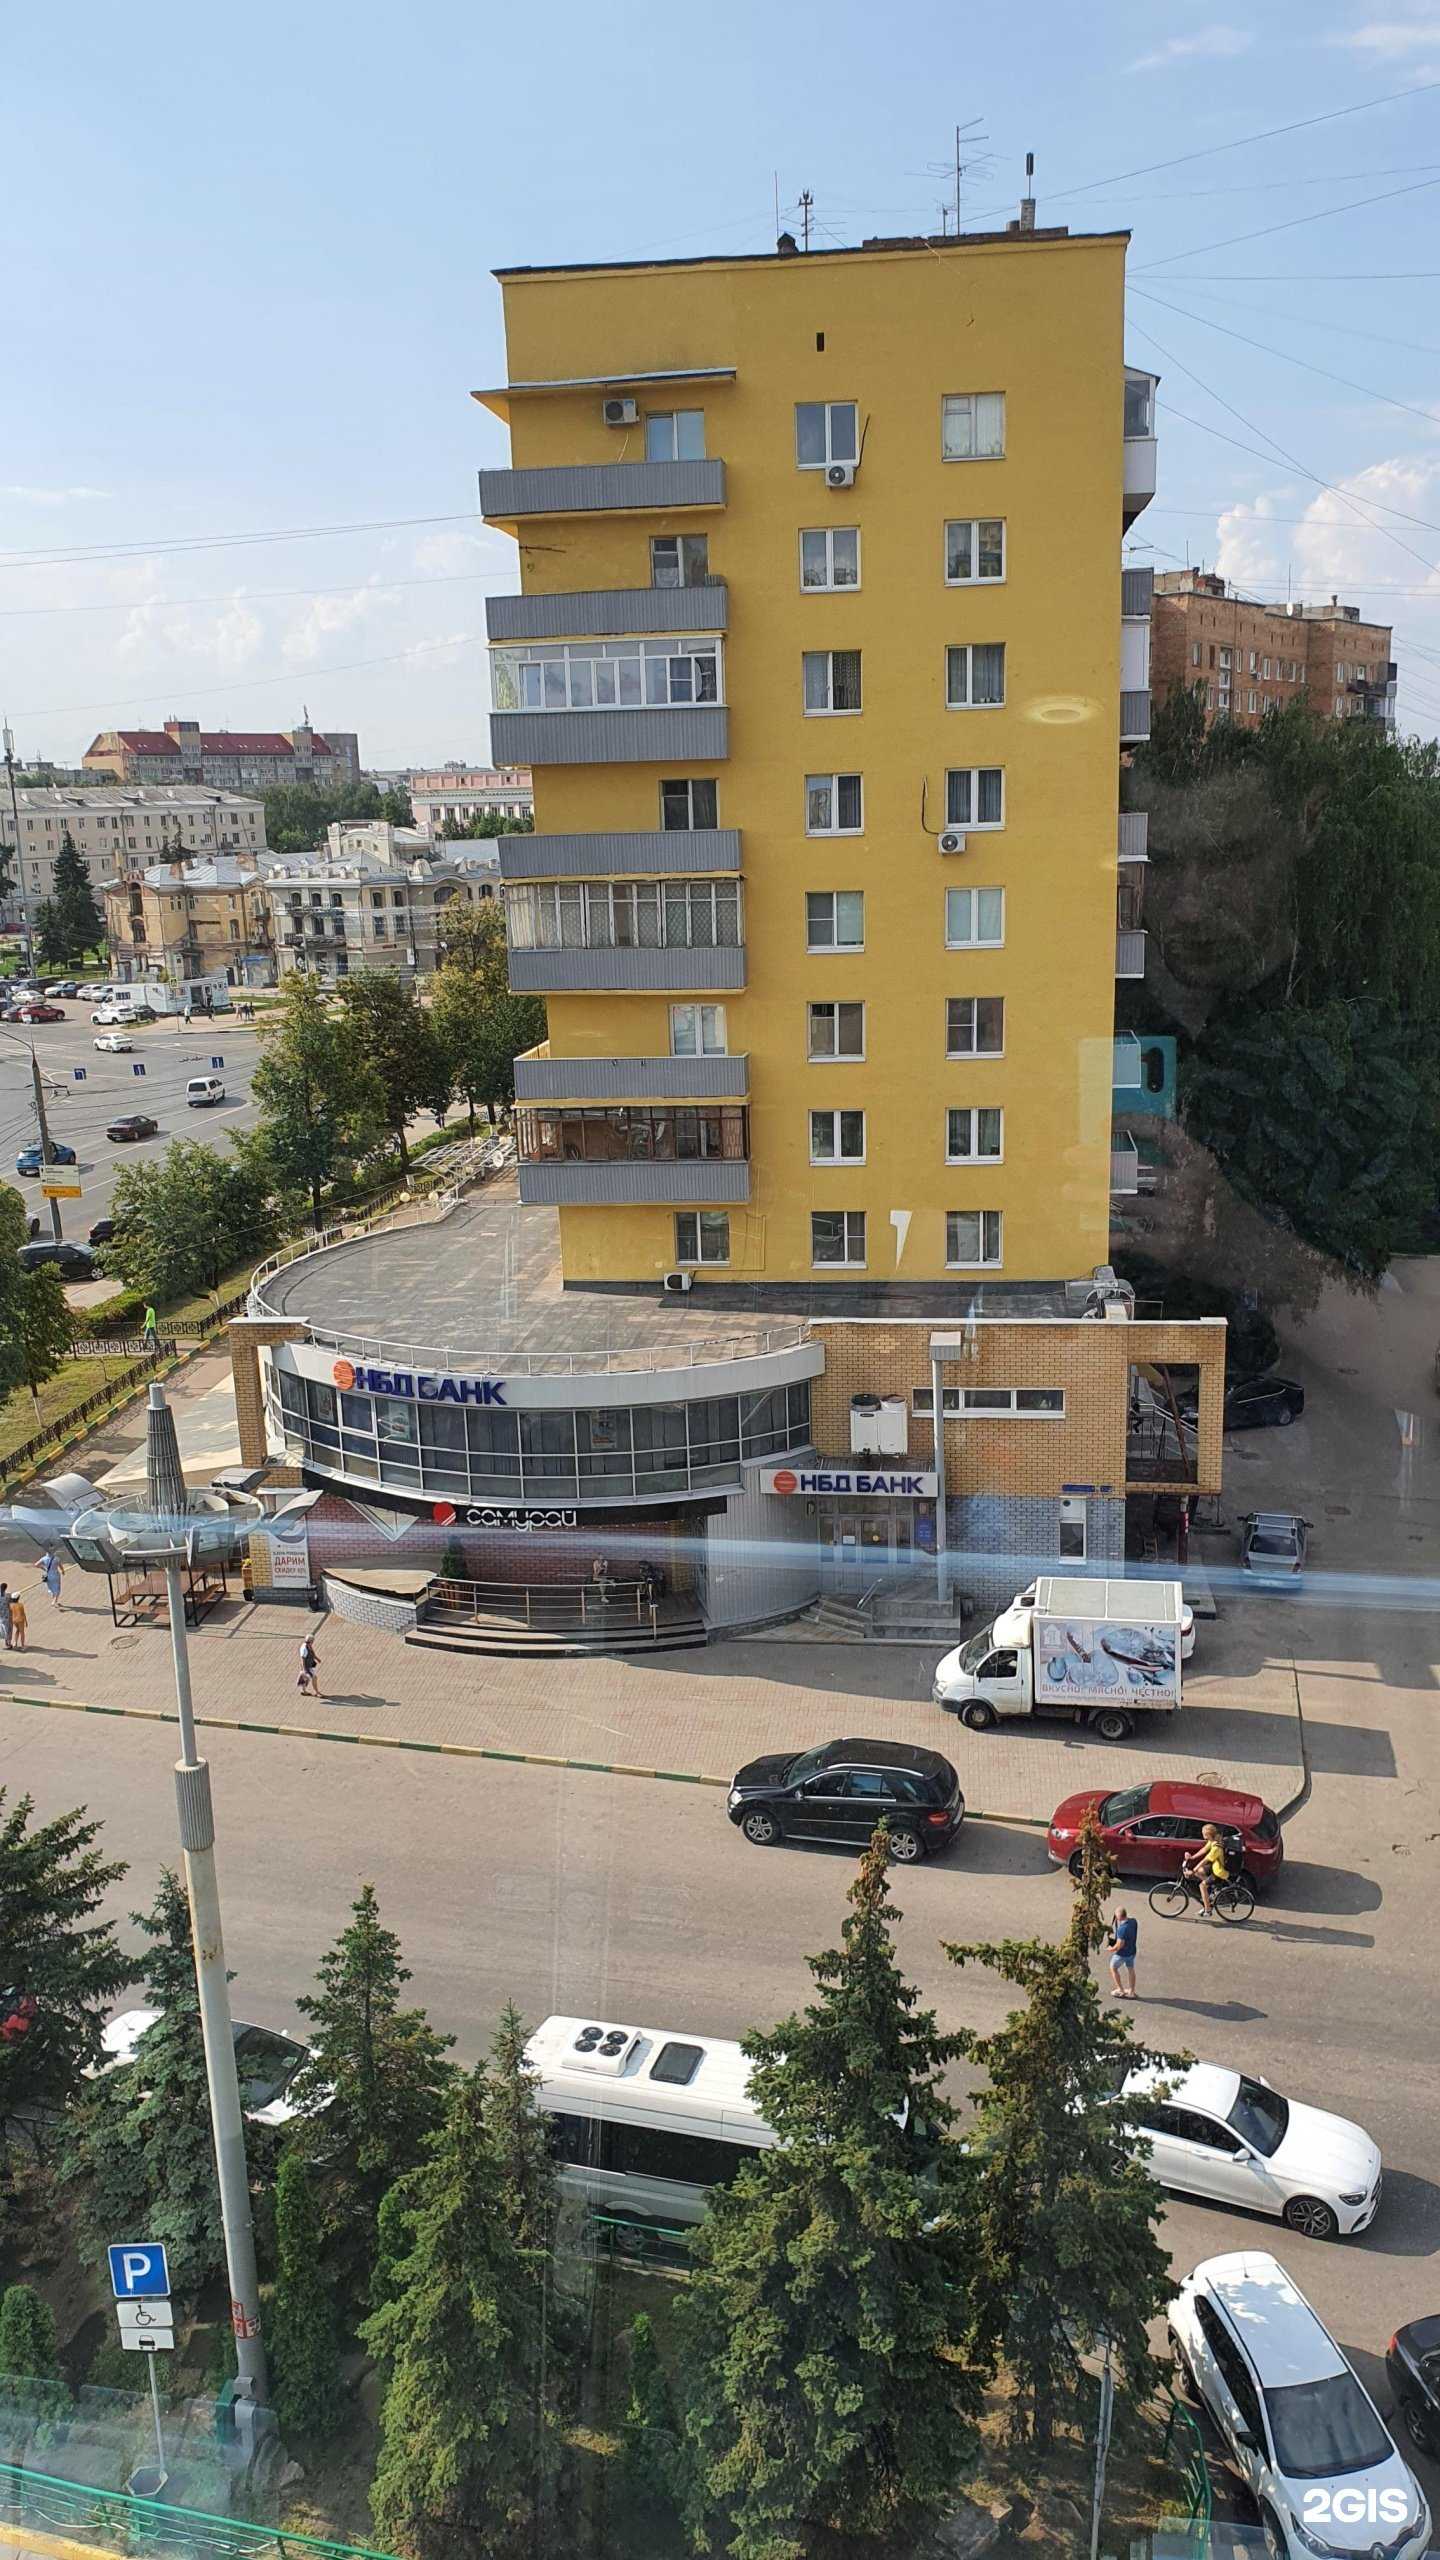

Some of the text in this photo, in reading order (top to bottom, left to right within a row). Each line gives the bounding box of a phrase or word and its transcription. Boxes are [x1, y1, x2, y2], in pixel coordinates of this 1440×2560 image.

[355, 1366, 508, 1406] НБД БАНК
[800, 1474, 924, 1494] НБД БАНК
[274, 1556, 306, 1566] ДАРИМ
[123, 2252, 152, 2290] P
